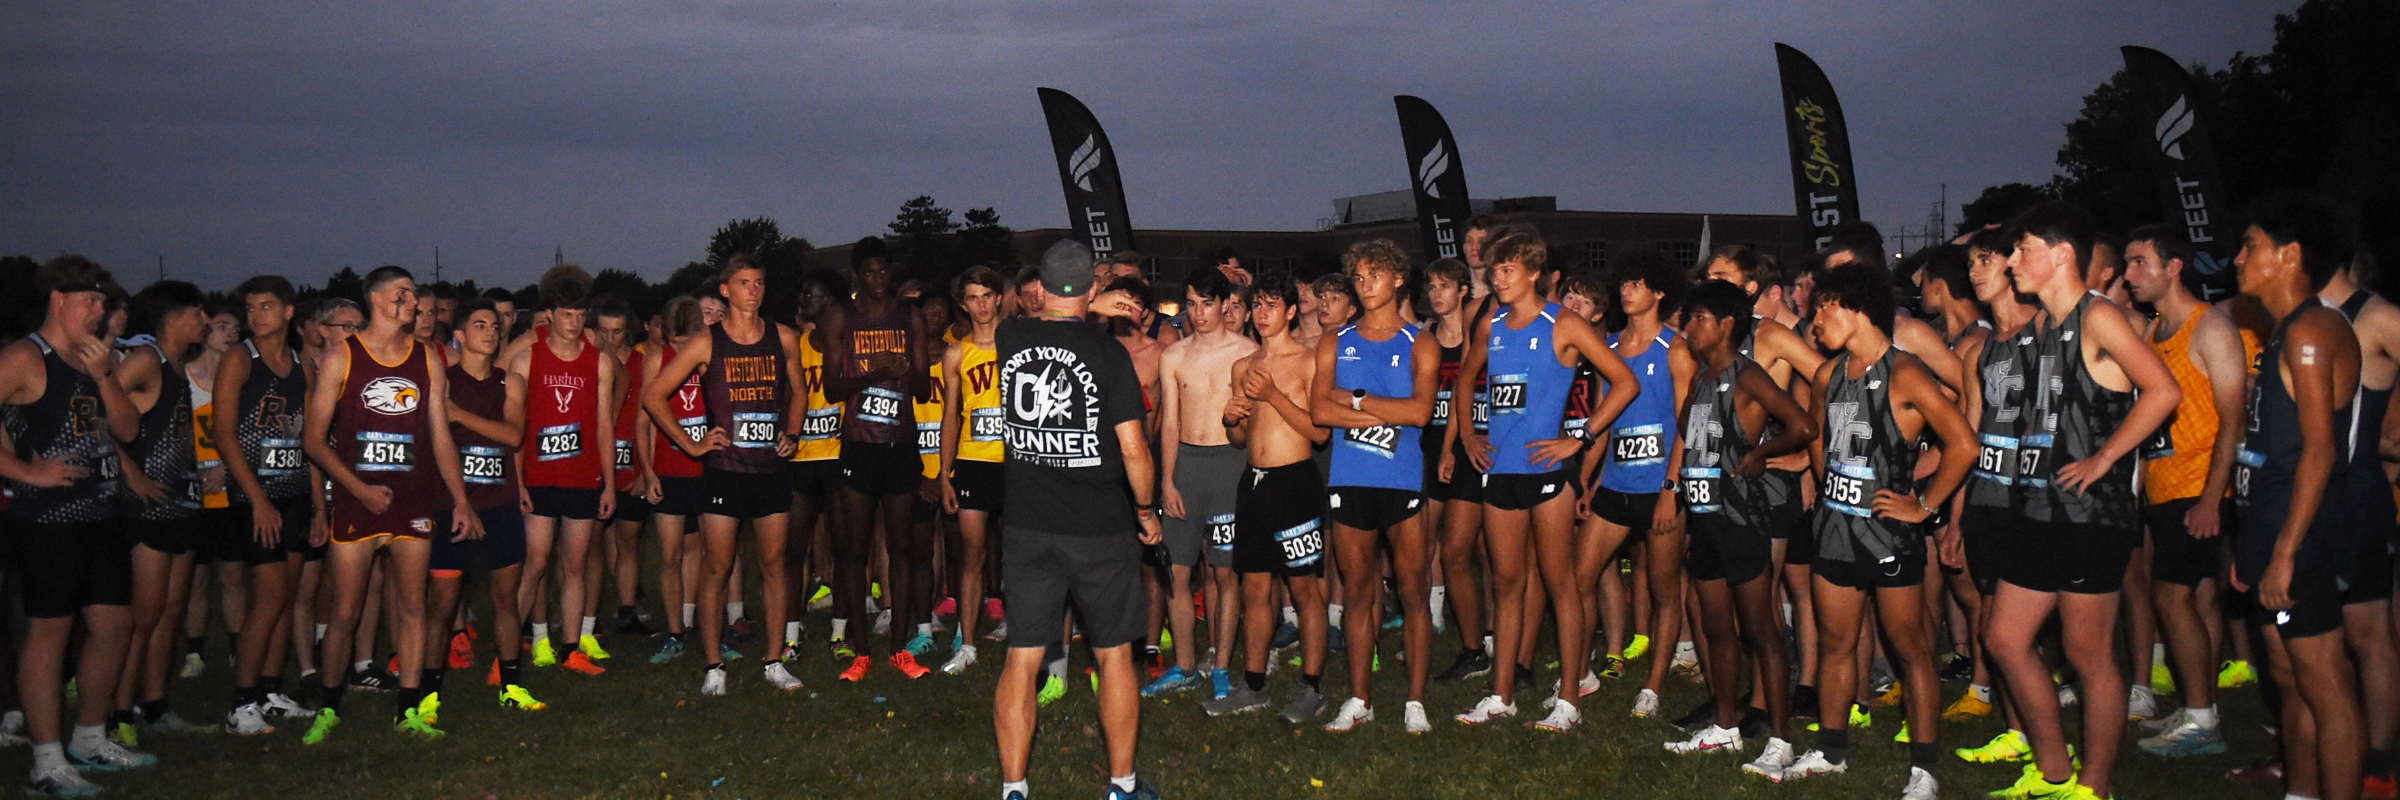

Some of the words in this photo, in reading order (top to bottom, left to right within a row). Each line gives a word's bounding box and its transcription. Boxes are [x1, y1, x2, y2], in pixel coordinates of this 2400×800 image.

[1795, 97, 1840, 187] Sports
[2175, 177, 2213, 243] FEET
[853, 329, 906, 354] WESTERVILLE
[544, 372, 587, 388] HARTLEY
[724, 355, 776, 383] WESTERVILLE
[966, 360, 996, 395] W
[1035, 346, 1076, 367] YOUR
[1072, 361, 1100, 417] LOCAL
[729, 387, 774, 402] NORTH
[862, 395, 899, 417] 4394
[738, 423, 775, 441] 4390
[802, 416, 838, 434] 4402
[975, 416, 1003, 435] 439
[541, 433, 579, 454] 4282
[1003, 424, 1100, 457] RUNNER
[1349, 425, 1395, 450] 4222
[1617, 435, 1659, 459] 4228
[265, 448, 302, 469] 4380
[363, 442, 405, 463] 4514
[616, 448, 630, 464] 76
[1978, 445, 2003, 473] 161
[464, 455, 503, 477] 5235
[1824, 471, 1863, 505] 5155
[1282, 532, 1323, 560] 5038
